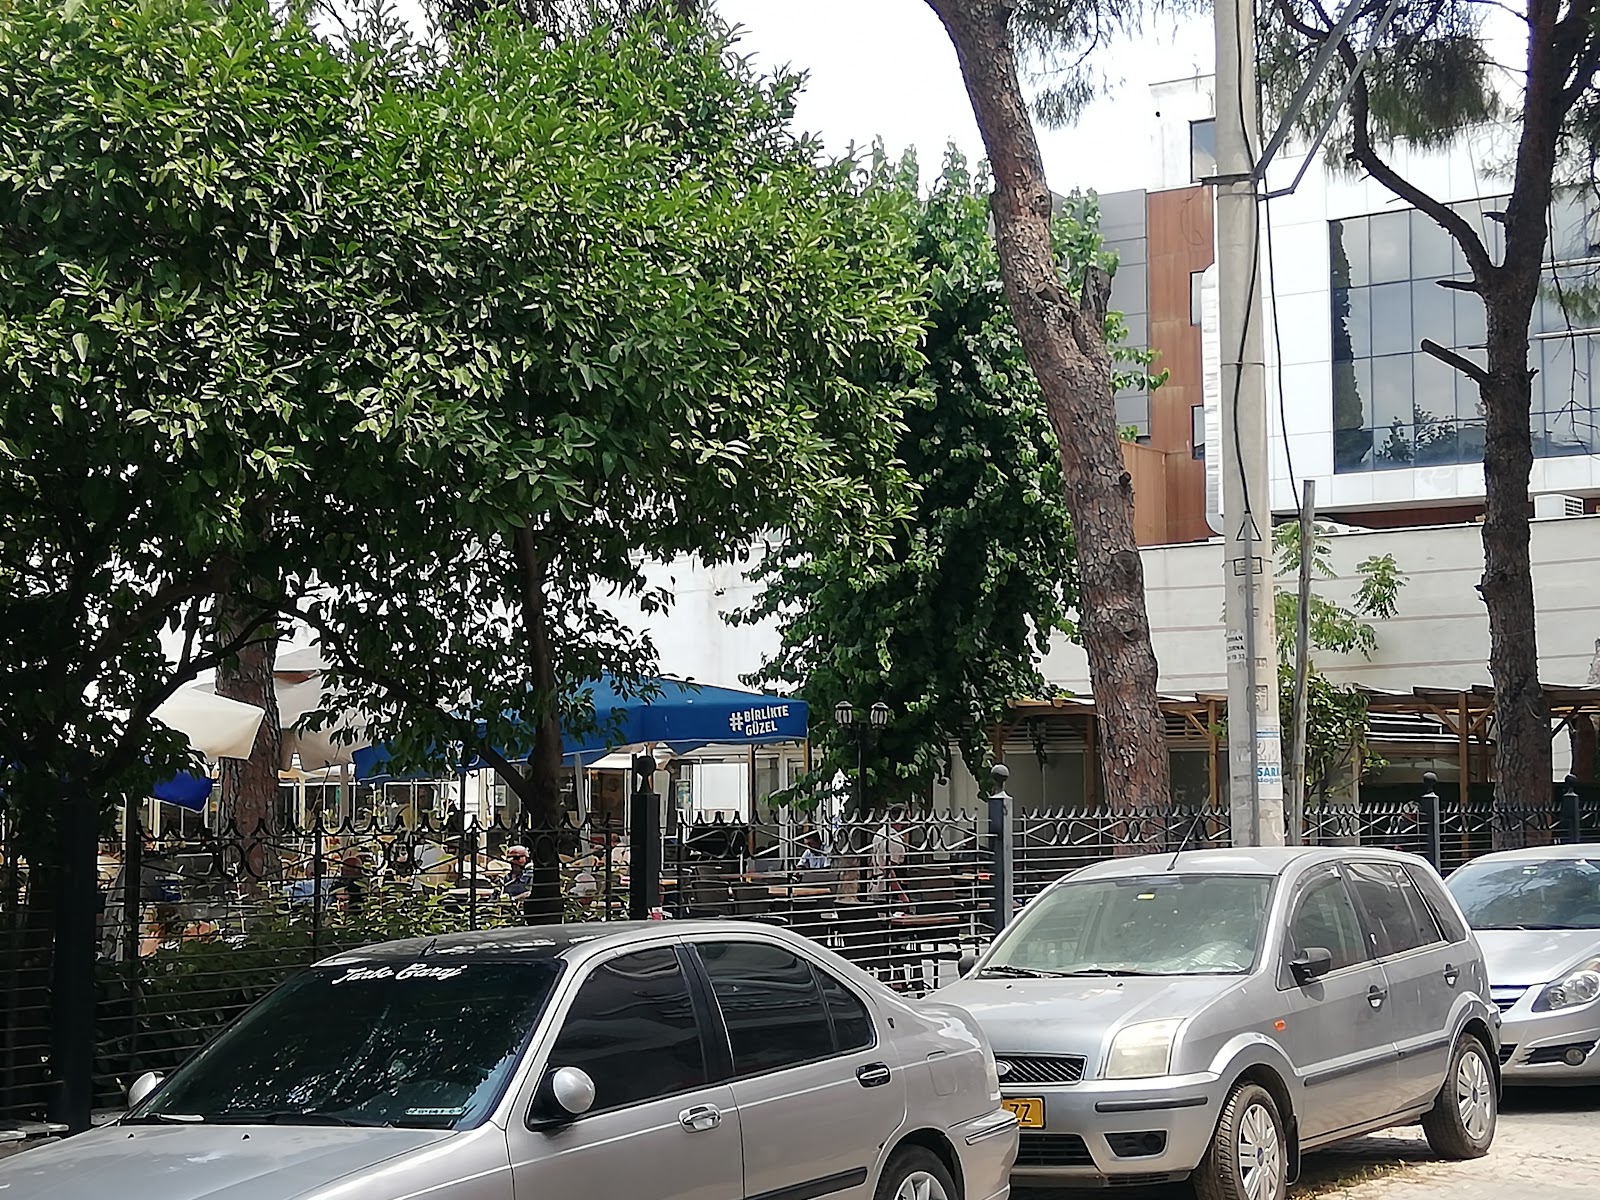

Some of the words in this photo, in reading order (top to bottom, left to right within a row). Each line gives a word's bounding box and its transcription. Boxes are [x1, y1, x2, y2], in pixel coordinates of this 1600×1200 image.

[745, 720, 778, 736] GÜZEL
[331, 966, 394, 985] Turbo
[395, 963, 467, 981] Garaj
